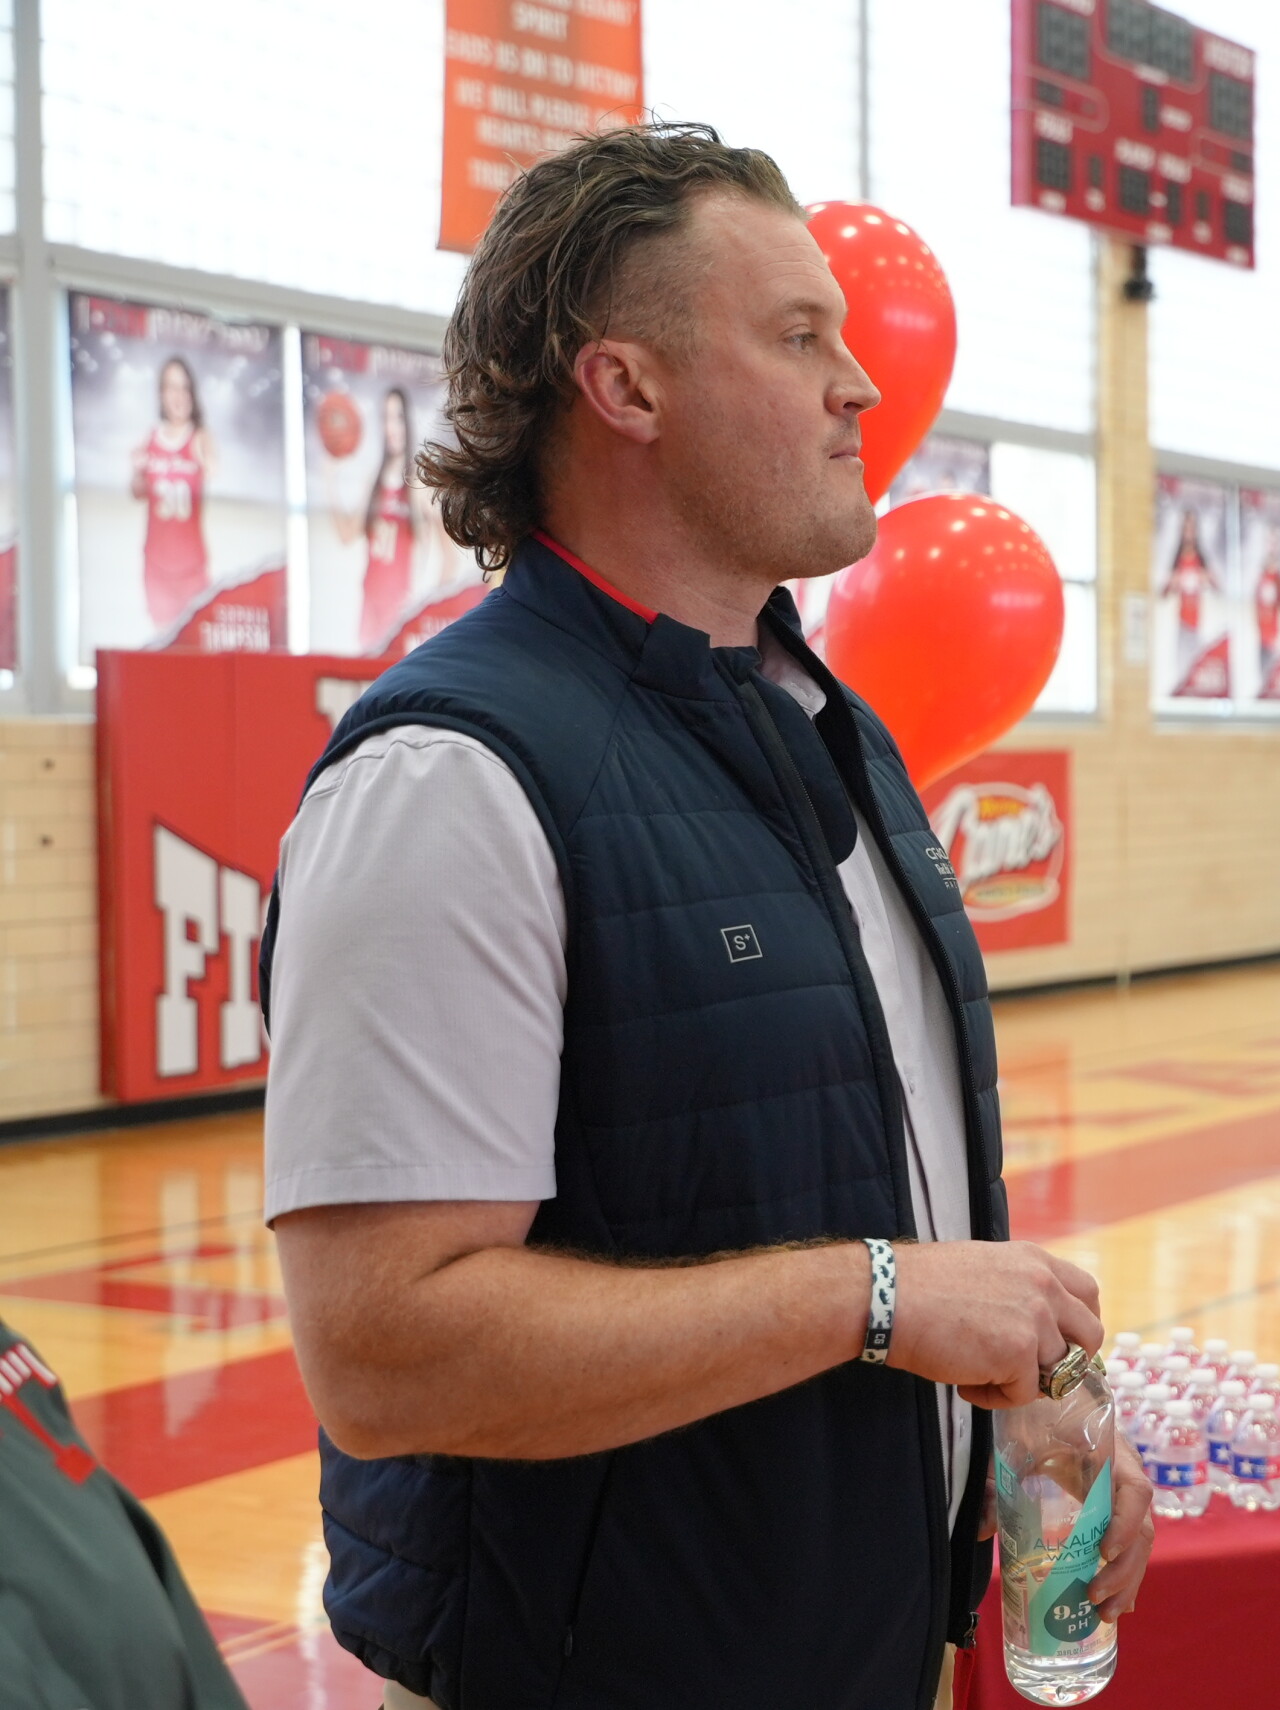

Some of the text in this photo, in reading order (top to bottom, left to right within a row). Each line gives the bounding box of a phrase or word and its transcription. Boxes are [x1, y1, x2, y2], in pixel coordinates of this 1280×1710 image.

[575, 61, 638, 102] VICTORY
[1033, 1514, 1109, 1551] ALKALINE
[1053, 1600, 1092, 1620] 9.5
